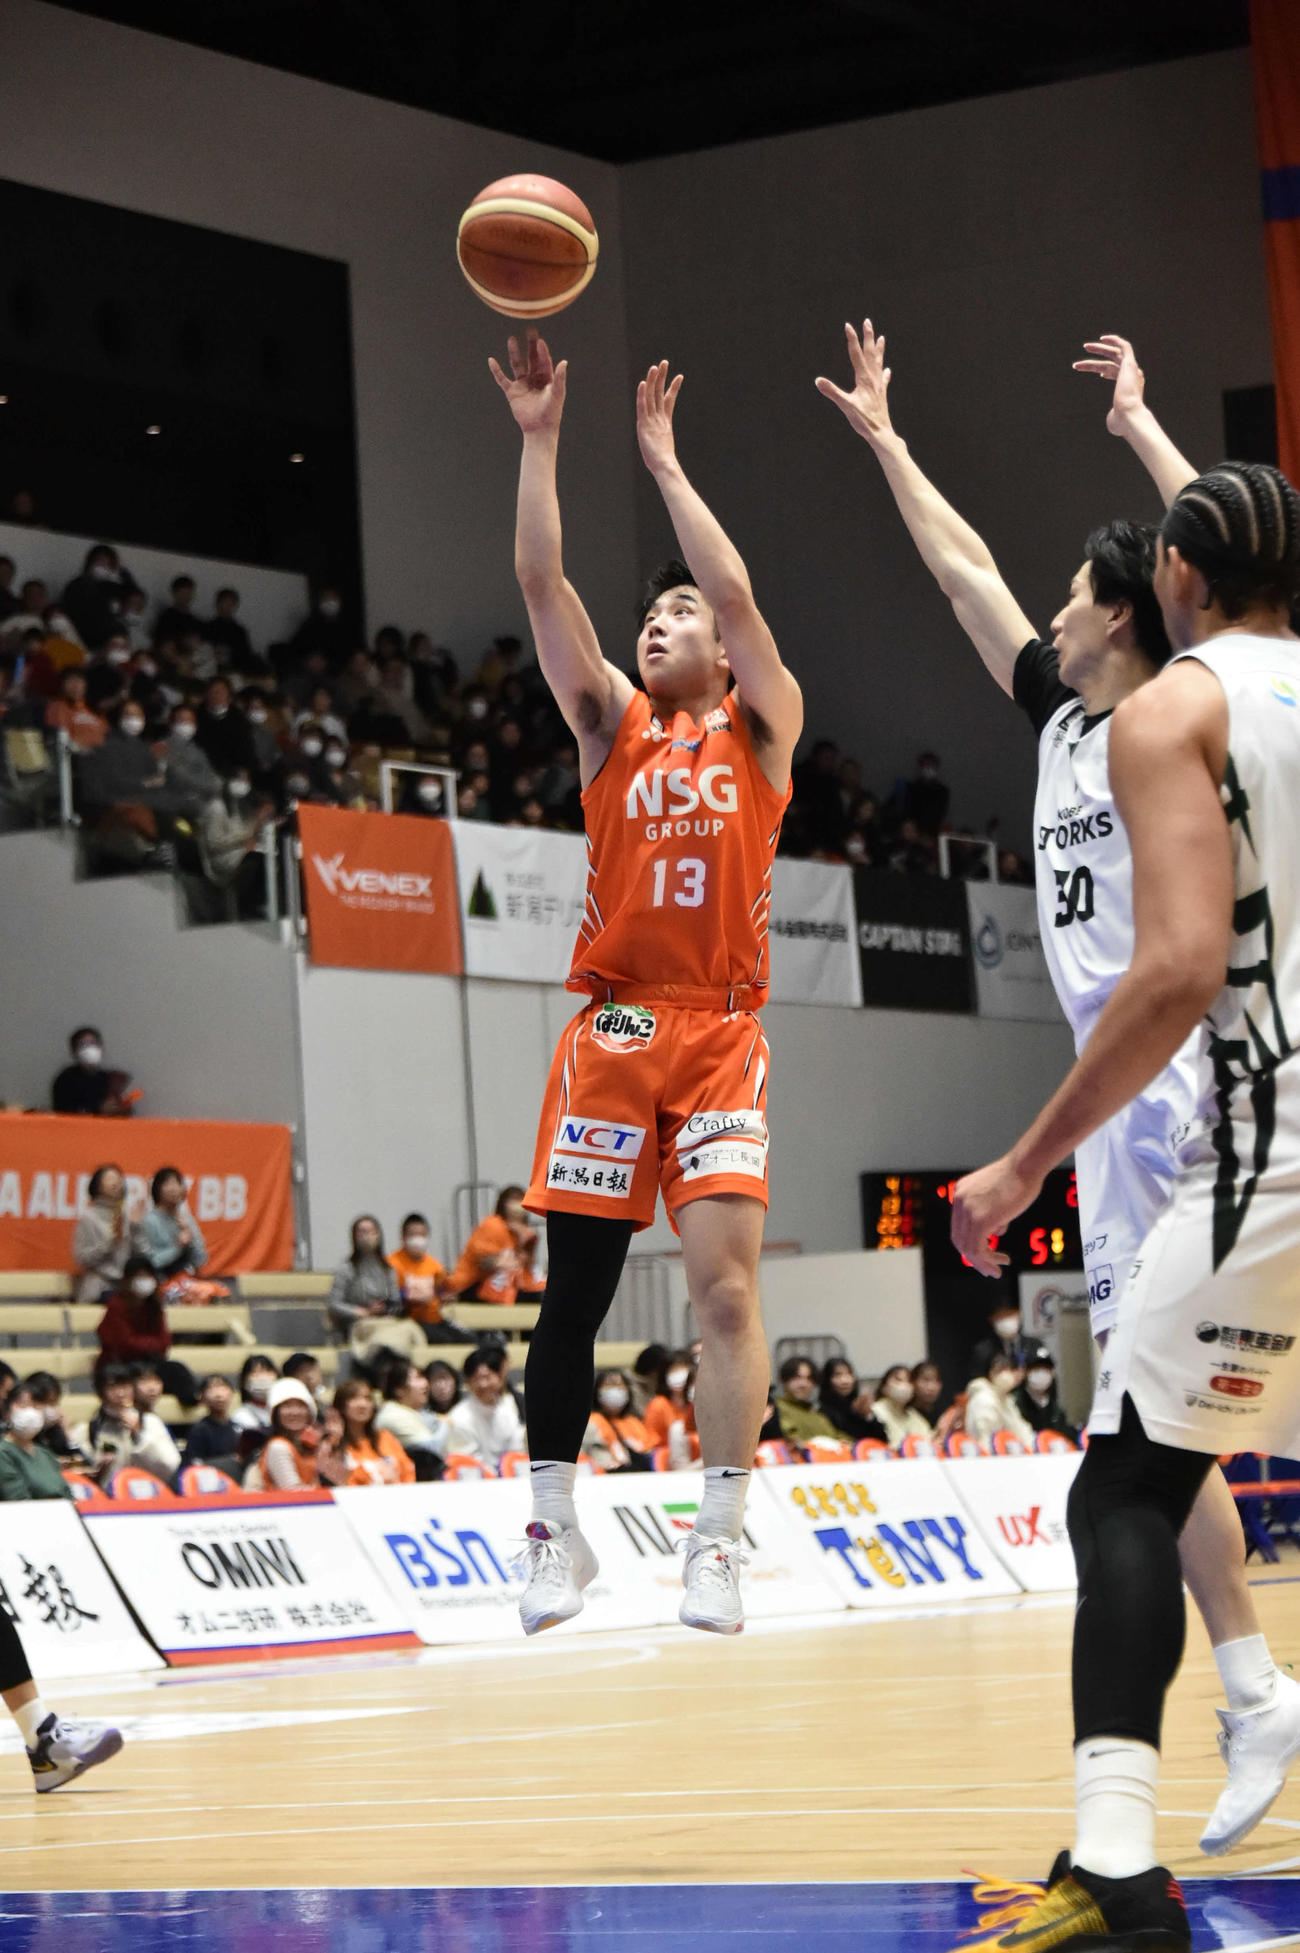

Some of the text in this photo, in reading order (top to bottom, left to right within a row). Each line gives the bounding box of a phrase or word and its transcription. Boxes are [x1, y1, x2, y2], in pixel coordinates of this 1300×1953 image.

[626, 764, 738, 819] NSG
[645, 819, 725, 841] GROUP
[653, 858, 707, 908] 13
[1053, 866, 1095, 928] 30
[596, 1009, 654, 1038] ぱりんこ
[561, 1123, 637, 1150] NCT
[198, 1175, 248, 1221] BB
[997, 1506, 1050, 1546] UX
[181, 1538, 306, 1589] OMNI
[814, 1516, 982, 1588] TeNY
